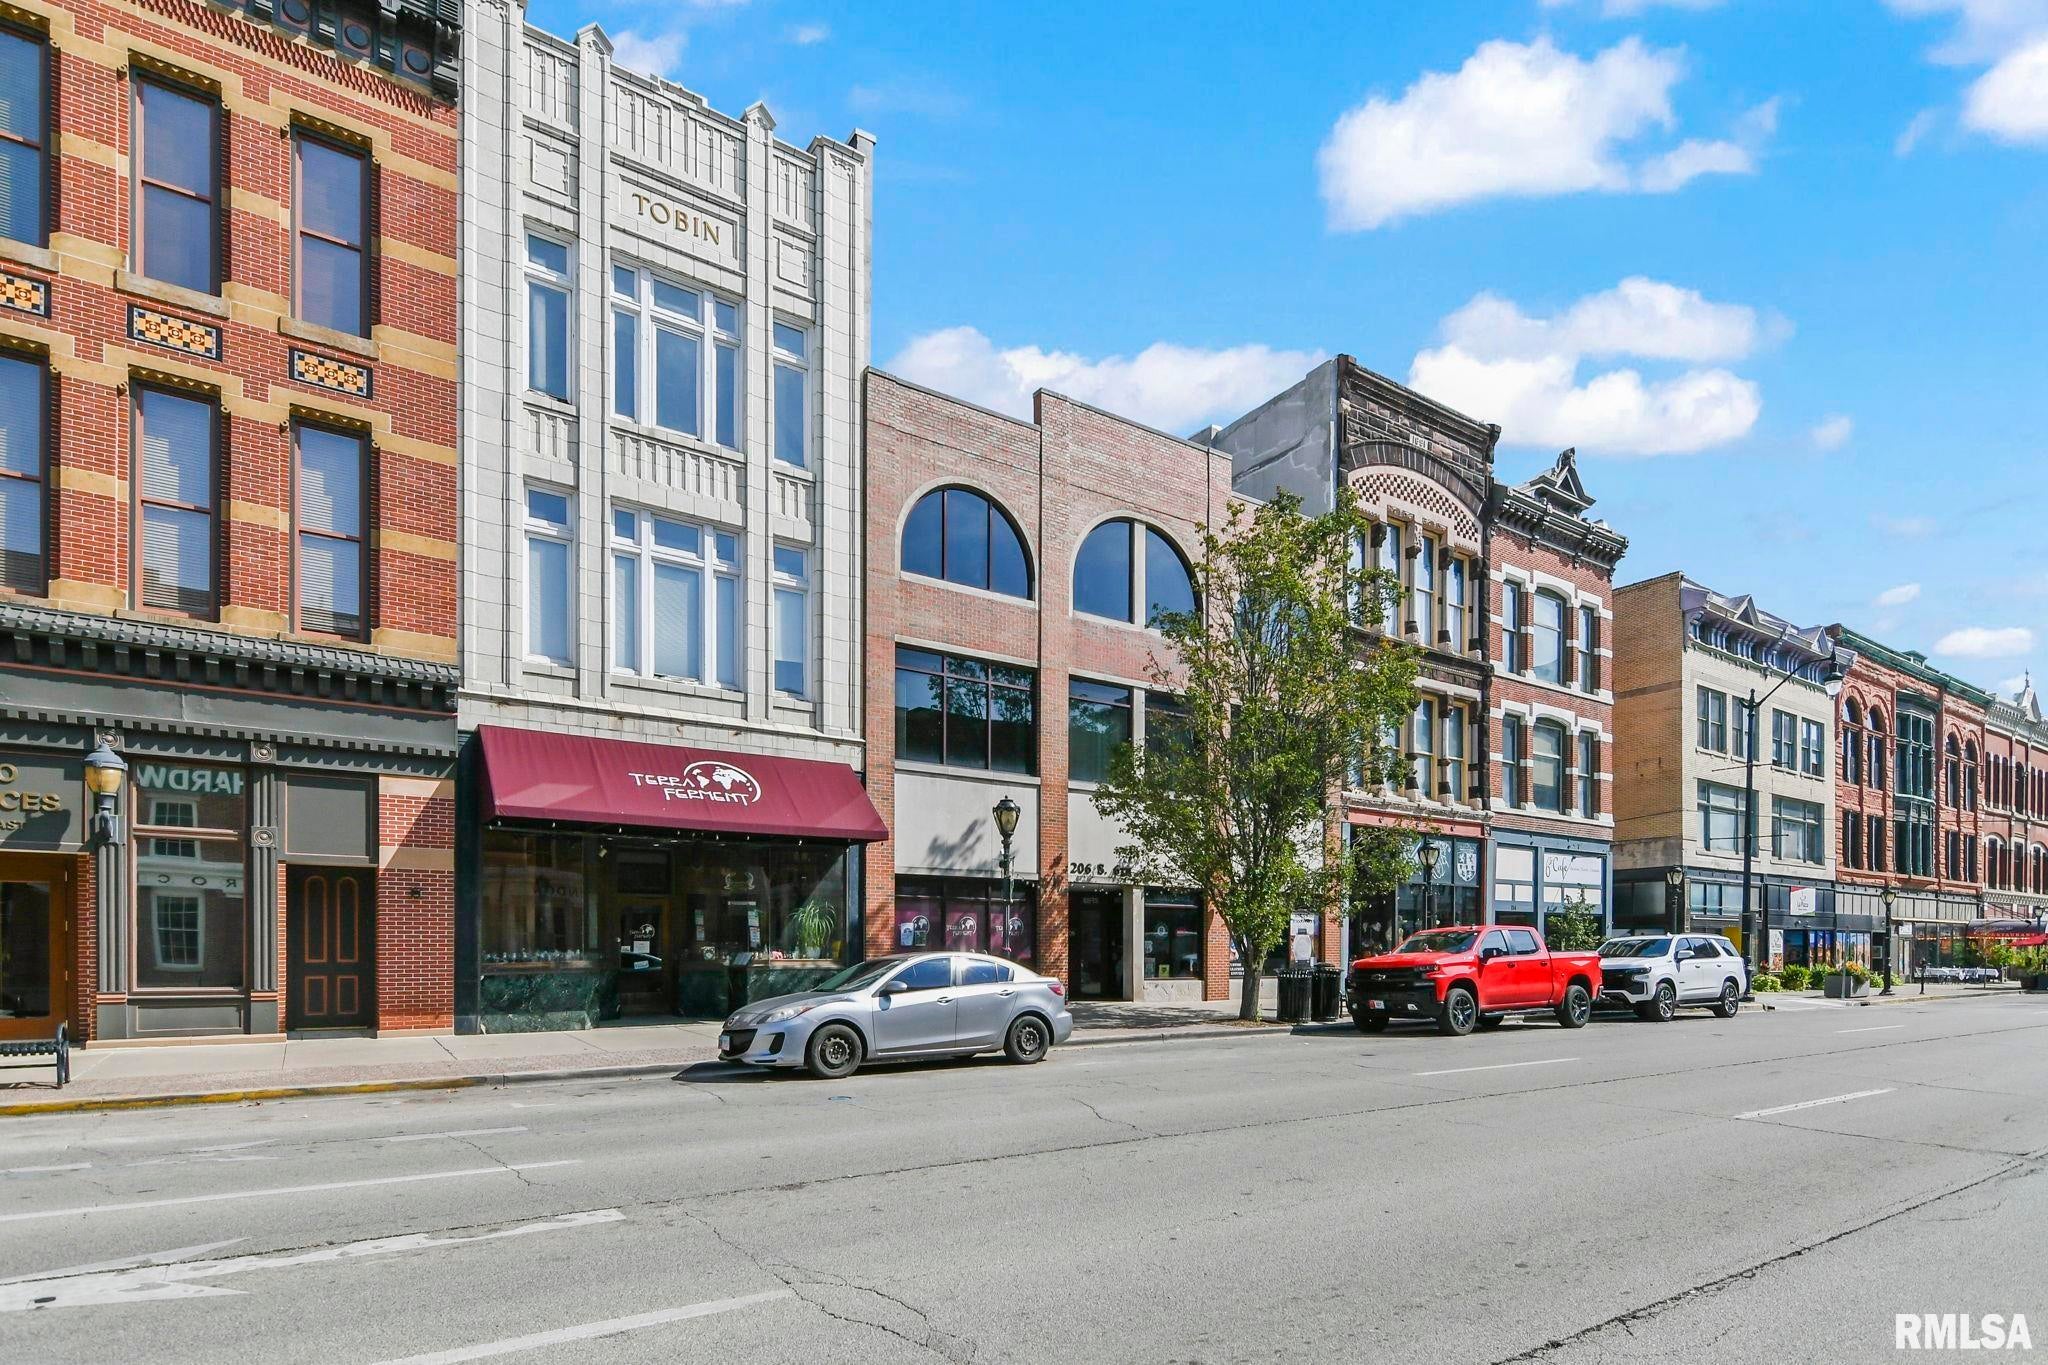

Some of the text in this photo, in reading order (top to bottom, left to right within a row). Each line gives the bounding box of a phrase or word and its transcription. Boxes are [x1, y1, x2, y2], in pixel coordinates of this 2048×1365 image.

[632, 193, 720, 246] TOBIN
[628, 772, 696, 787] TERRA
[663, 788, 749, 806] FERMENT
[1070, 862, 1091, 875] 206
